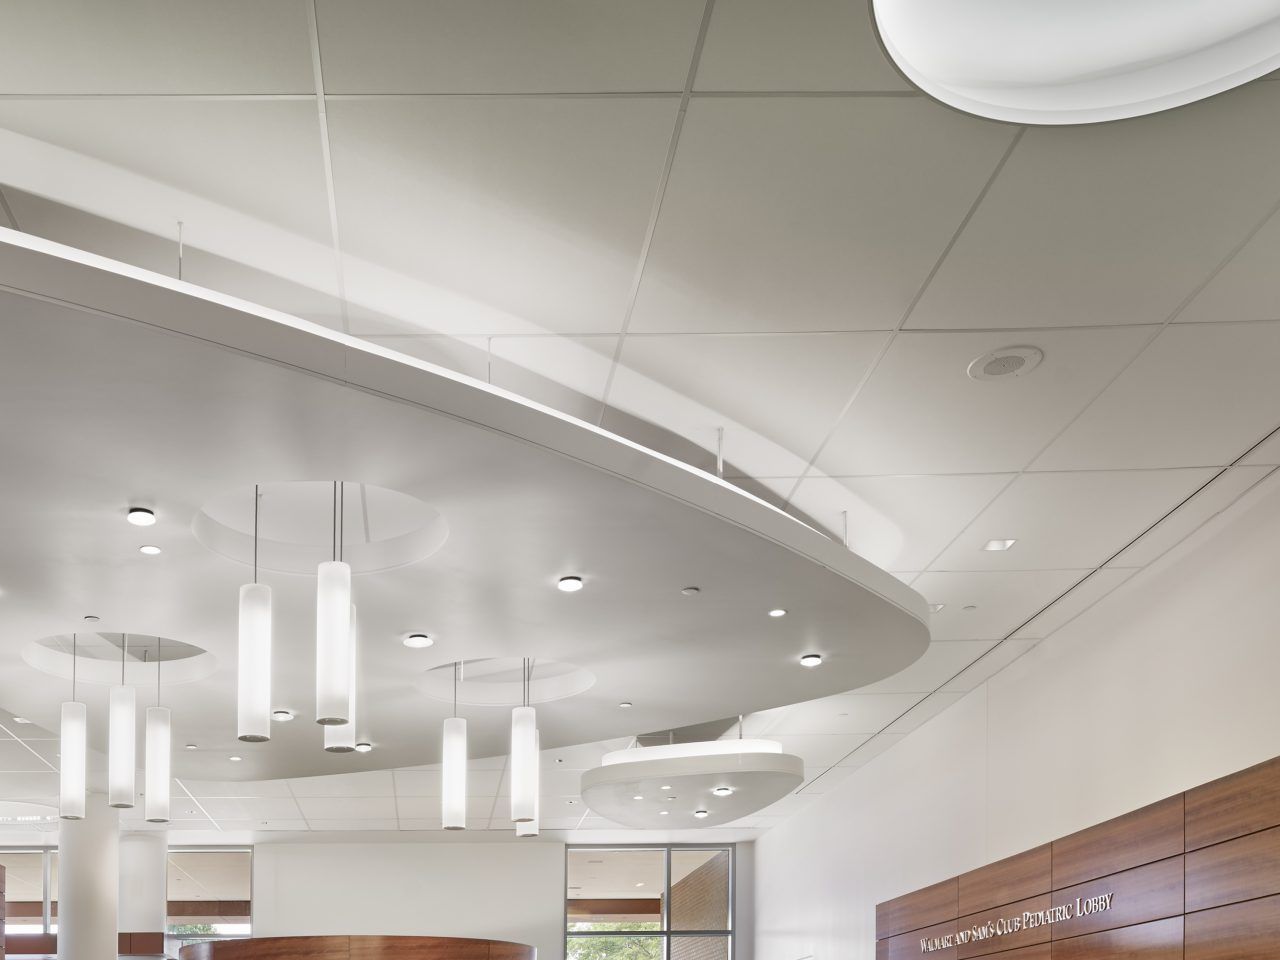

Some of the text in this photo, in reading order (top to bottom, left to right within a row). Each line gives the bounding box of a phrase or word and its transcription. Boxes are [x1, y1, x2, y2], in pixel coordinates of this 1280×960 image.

[920, 892, 1113, 953] WALMART AND SAM'S CLUB PEDIATRIC LOBBY
